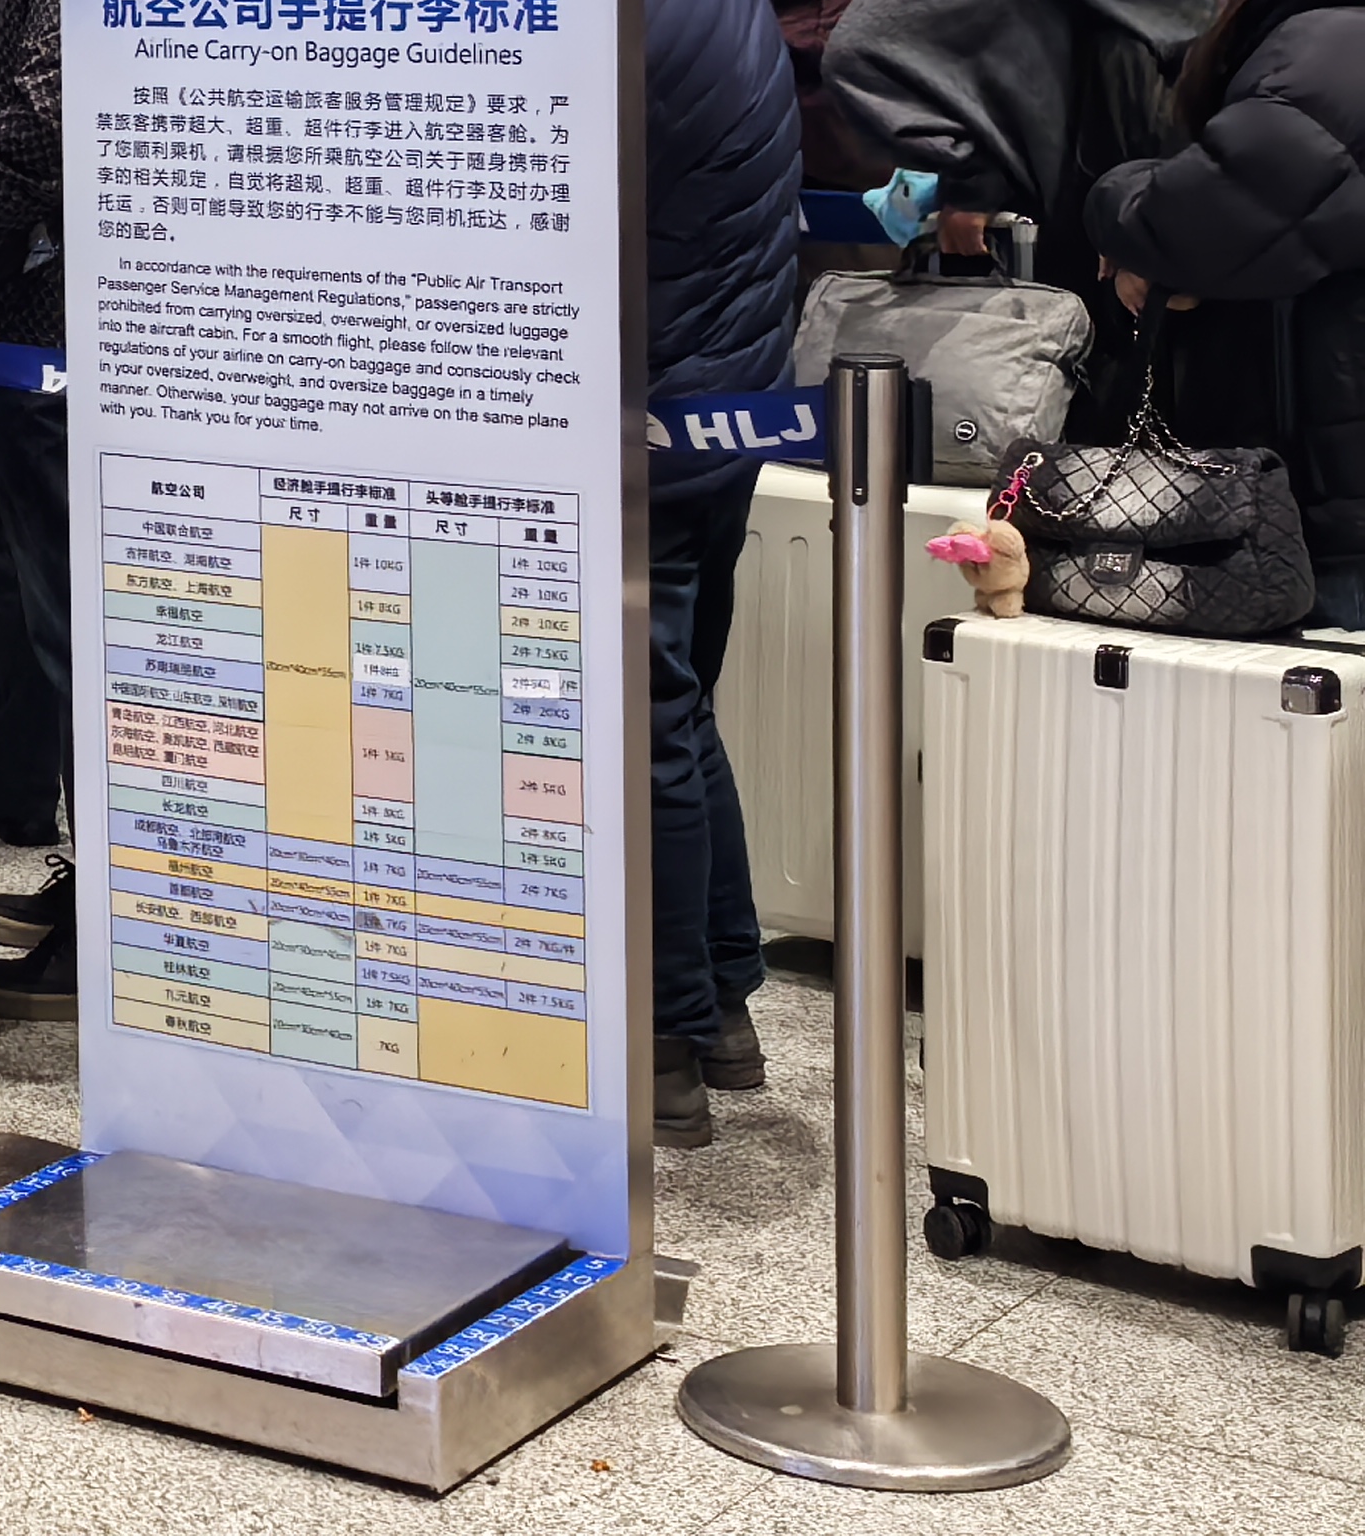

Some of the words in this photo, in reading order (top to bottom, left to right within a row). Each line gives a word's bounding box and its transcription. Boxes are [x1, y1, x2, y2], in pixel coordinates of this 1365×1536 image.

[134, 37, 200, 61] Airline
[204, 38, 299, 67] Carry-on
[304, 40, 401, 70] Baggage
[405, 41, 524, 66] Guidelines
[119, 256, 132, 270] In
[135, 260, 212, 276] accordance
[214, 264, 243, 278] with
[245, 263, 269, 279] the
[271, 266, 364, 284] requirements
[366, 270, 382, 285] of
[384, 271, 407, 287] the
[464, 275, 486, 291] Air
[489, 276, 564, 297] Transport
[97, 275, 168, 296] Passenger
[170, 280, 221, 298] Service
[224, 283, 315, 304] Management
[415, 297, 501, 316] passengers
[503, 302, 529, 315] are
[532, 301, 580, 321] strictly
[97, 298, 162, 315] prohibited
[164, 301, 196, 317] from
[198, 305, 253, 324] carrying
[415, 319, 432, 331] or
[433, 319, 505, 336] oversized
[508, 321, 569, 343] luggage
[98, 317, 123, 333] into
[124, 319, 147, 335] the
[148, 321, 196, 338] aircraft
[242, 327, 268, 342] For
[268, 331, 279, 344] a
[281, 332, 334, 347] smooth
[378, 336, 428, 354] please
[430, 338, 474, 356] follow
[475, 342, 502, 358] the
[503, 343, 565, 362] relevant
[98, 340, 170, 357] regulations
[172, 344, 188, 358] of
[188, 347, 220, 362] your
[222, 347, 265, 364] airline
[266, 353, 285, 366] on
[288, 354, 347, 371] carry-on
[349, 355, 414, 377] baggage
[414, 361, 443, 377] and
[446, 365, 534, 386] consciously
[535, 368, 581, 386] check
[99, 400, 127, 416] with
[159, 405, 204, 423] Thank
[204, 411, 231, 426] you
[233, 411, 254, 427] for
[254, 415, 289, 431] your
[151, 480, 206, 500] 航空公司
[273, 476, 397, 501] 经济舱手提行李标准
[426, 489, 556, 515] 头等舱手提行李标准
[142, 520, 214, 540] 中国联合航空
[584, 1258, 608, 1270] 5
[557, 1272, 592, 1285] 10
[533, 1285, 570, 1299] 15
[508, 1298, 546, 1314] 20
[484, 1313, 525, 1329] 25
[461, 1328, 500, 1343] 30
